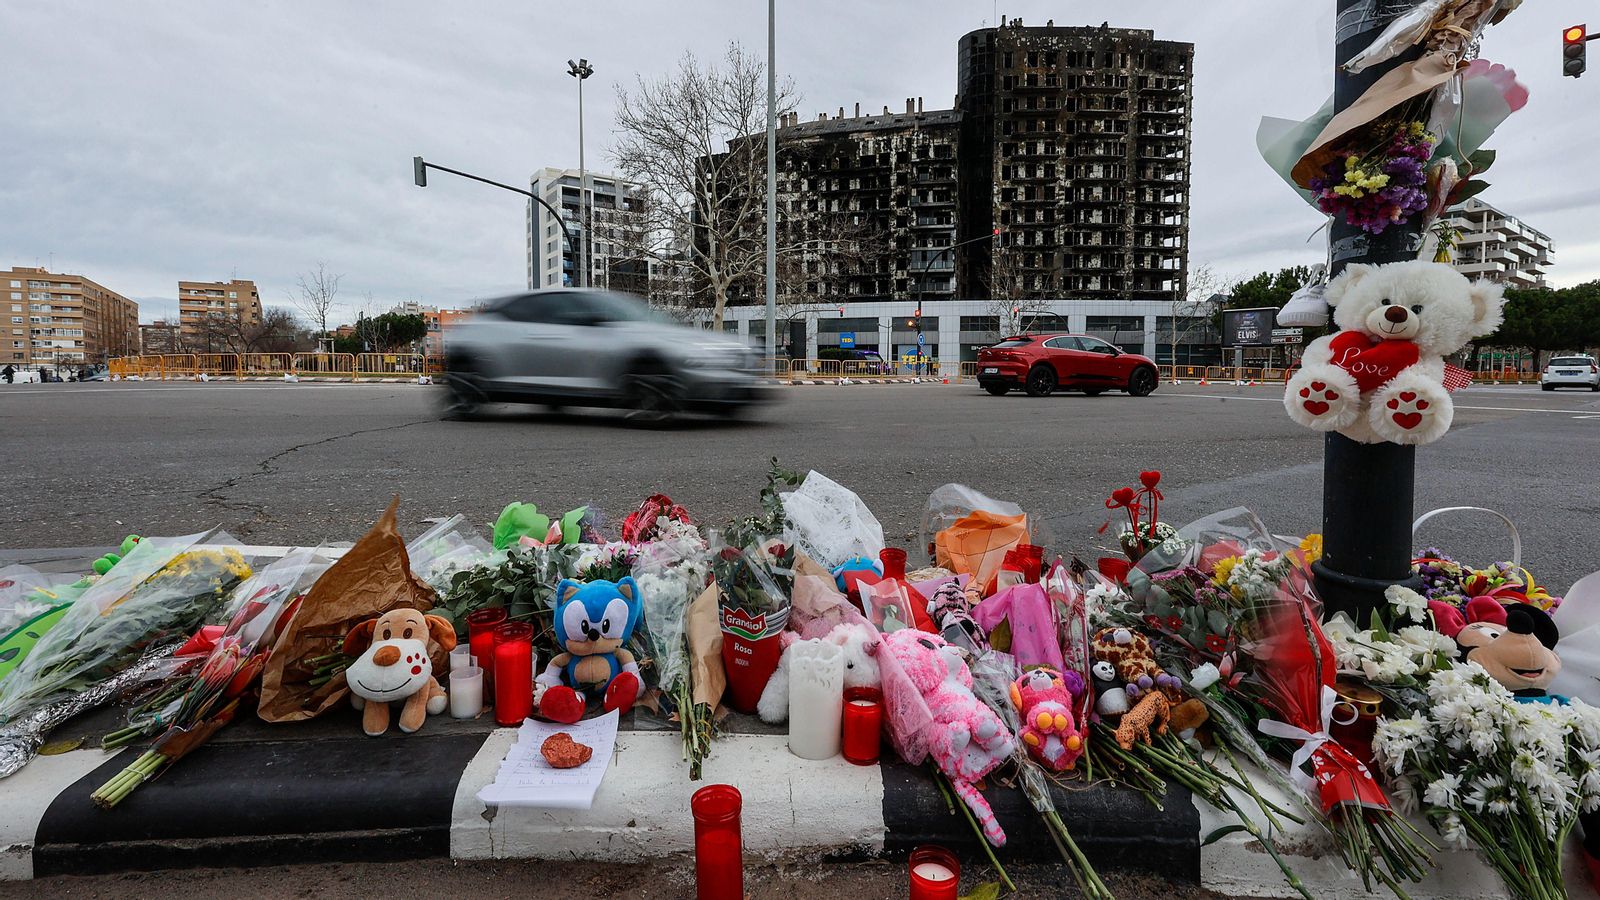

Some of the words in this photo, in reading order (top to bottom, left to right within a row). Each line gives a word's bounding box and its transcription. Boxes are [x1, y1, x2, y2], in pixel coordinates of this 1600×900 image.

[1237, 330, 1257, 339] ELVIS
[1334, 346, 1391, 377] Love
[726, 614, 763, 631] Grandiol
[734, 642, 753, 655] Rosa
